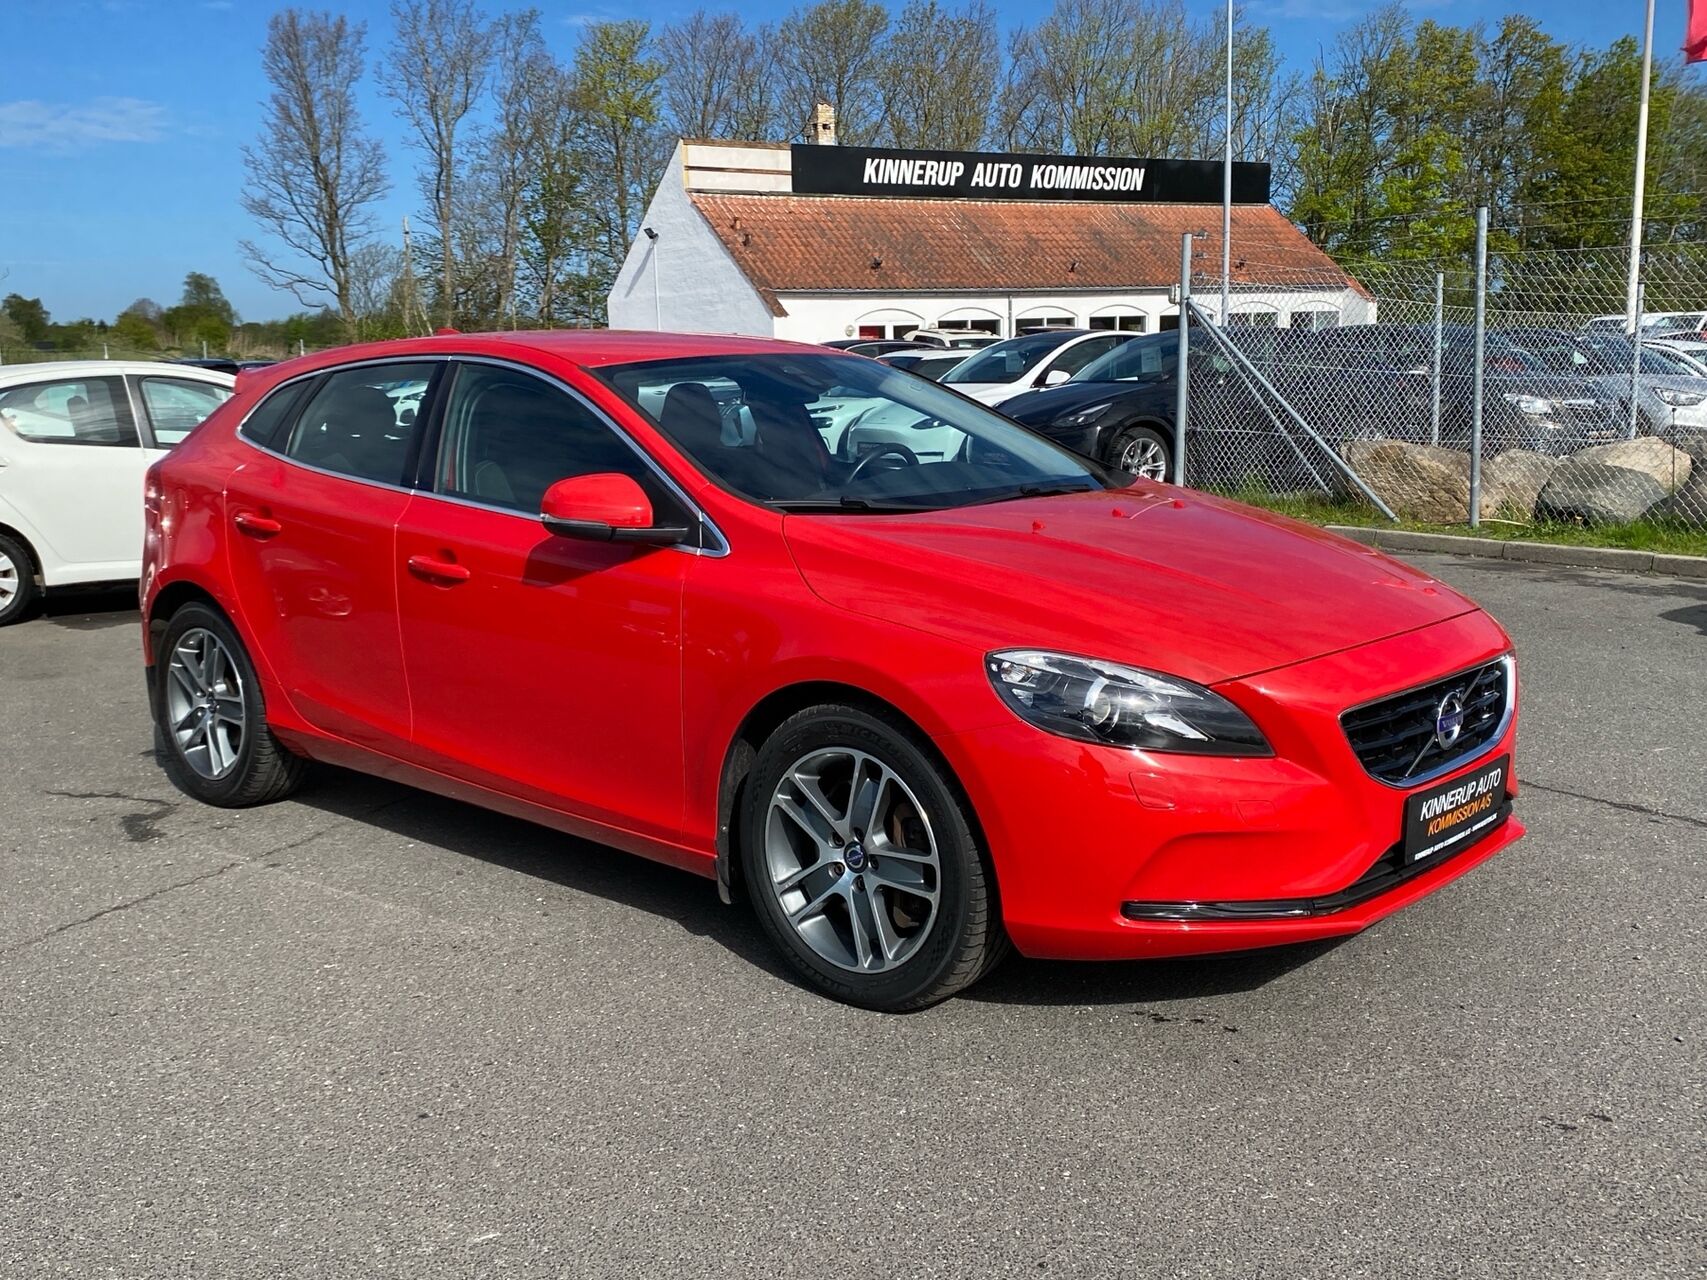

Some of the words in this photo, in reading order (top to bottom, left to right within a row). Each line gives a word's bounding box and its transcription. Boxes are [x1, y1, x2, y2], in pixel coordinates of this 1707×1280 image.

[863, 158, 964, 186] KINNERUP
[970, 162, 1022, 188] AUTO
[1030, 164, 1145, 191] KOMMISSION
[1420, 781, 1476, 821] KINNERUP
[1475, 768, 1501, 797] AUTO
[1428, 799, 1480, 837] KOMMISSION
